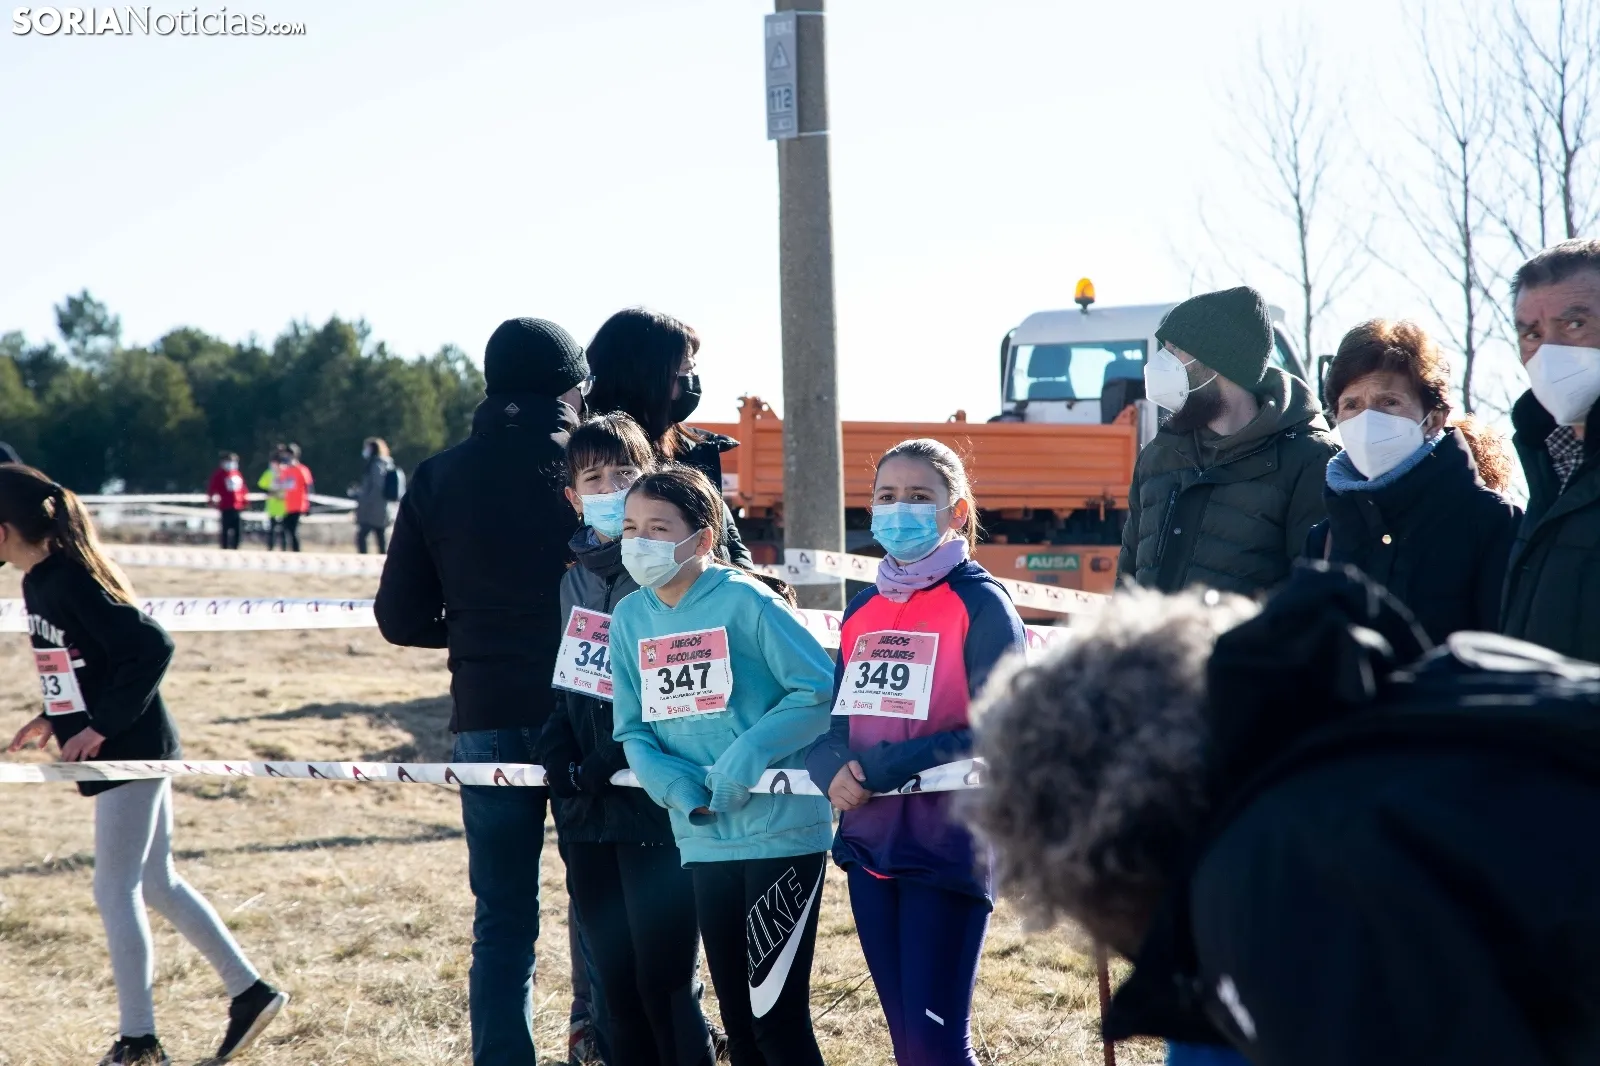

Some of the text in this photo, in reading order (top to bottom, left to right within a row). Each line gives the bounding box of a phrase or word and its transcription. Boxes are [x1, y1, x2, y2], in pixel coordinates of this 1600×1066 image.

[1028, 556, 1078, 569] AUSA
[670, 636, 702, 649] JUEGOS
[878, 635, 911, 646] JUEGOS
[666, 649, 712, 663] ESCOLARES
[871, 649, 916, 660] ESCOLARES
[657, 662, 712, 694] 347
[855, 661, 910, 691] 349
